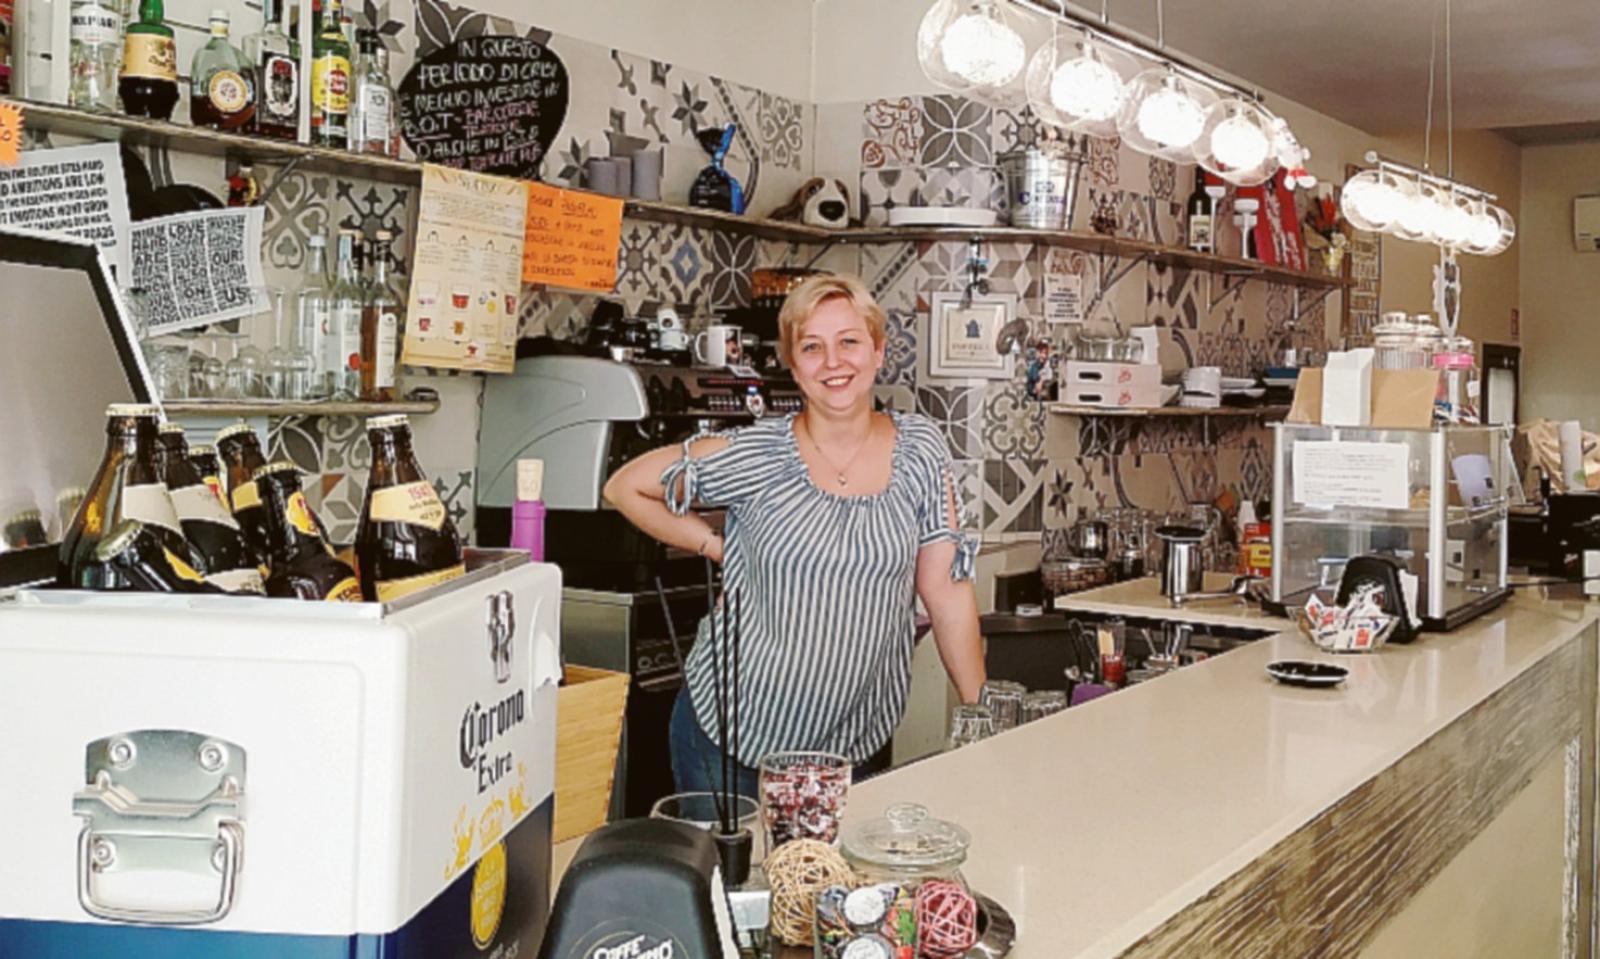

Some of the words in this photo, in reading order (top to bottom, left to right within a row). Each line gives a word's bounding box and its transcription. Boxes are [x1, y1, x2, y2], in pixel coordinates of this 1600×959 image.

[460, 39, 477, 57] IN
[481, 37, 541, 58] QUESTO
[417, 62, 495, 90] PERIODO
[500, 63, 518, 82] DI
[414, 89, 471, 117] MEGLIO
[478, 751, 512, 794] Extra
